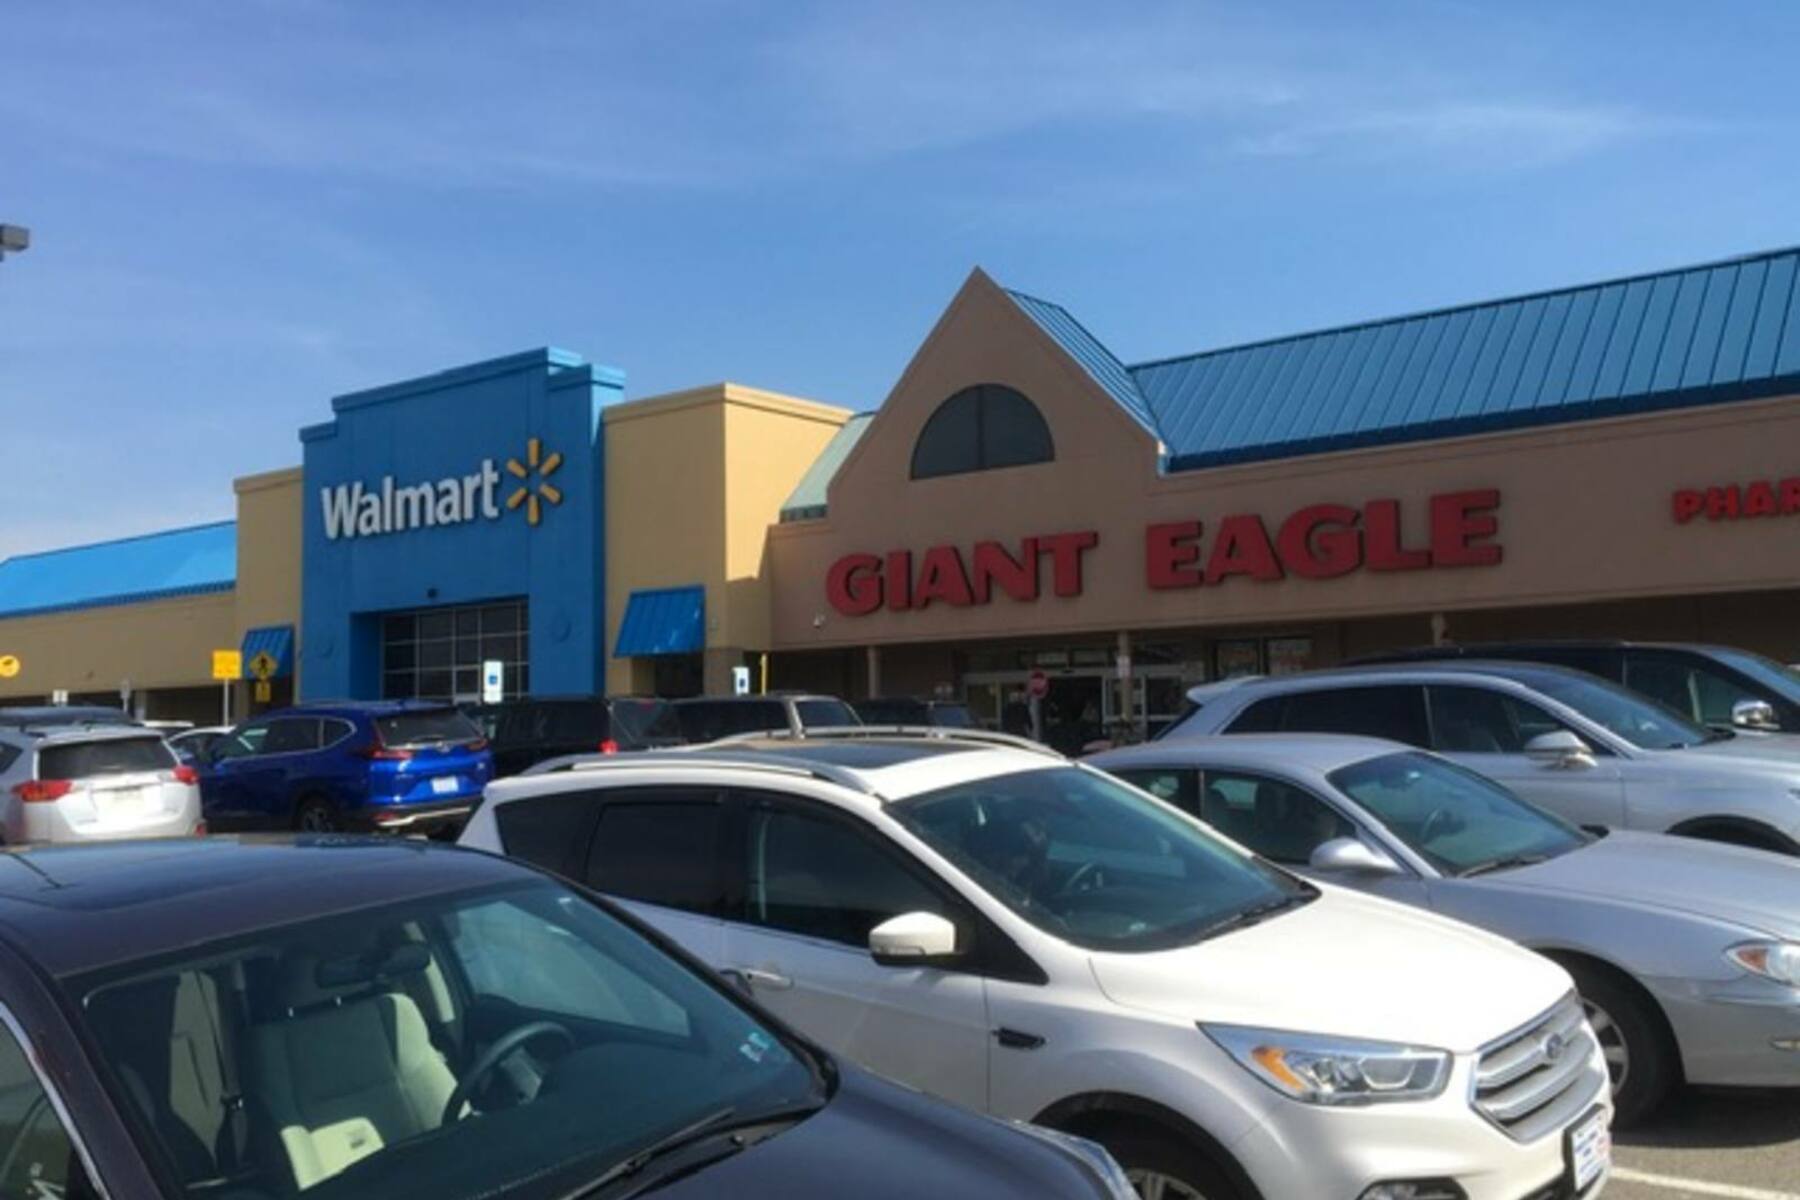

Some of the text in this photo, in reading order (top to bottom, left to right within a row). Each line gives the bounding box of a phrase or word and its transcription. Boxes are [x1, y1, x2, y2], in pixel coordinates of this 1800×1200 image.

[320, 457, 500, 540] Walmart
[826, 489, 1503, 617] GIANT EAGLE
